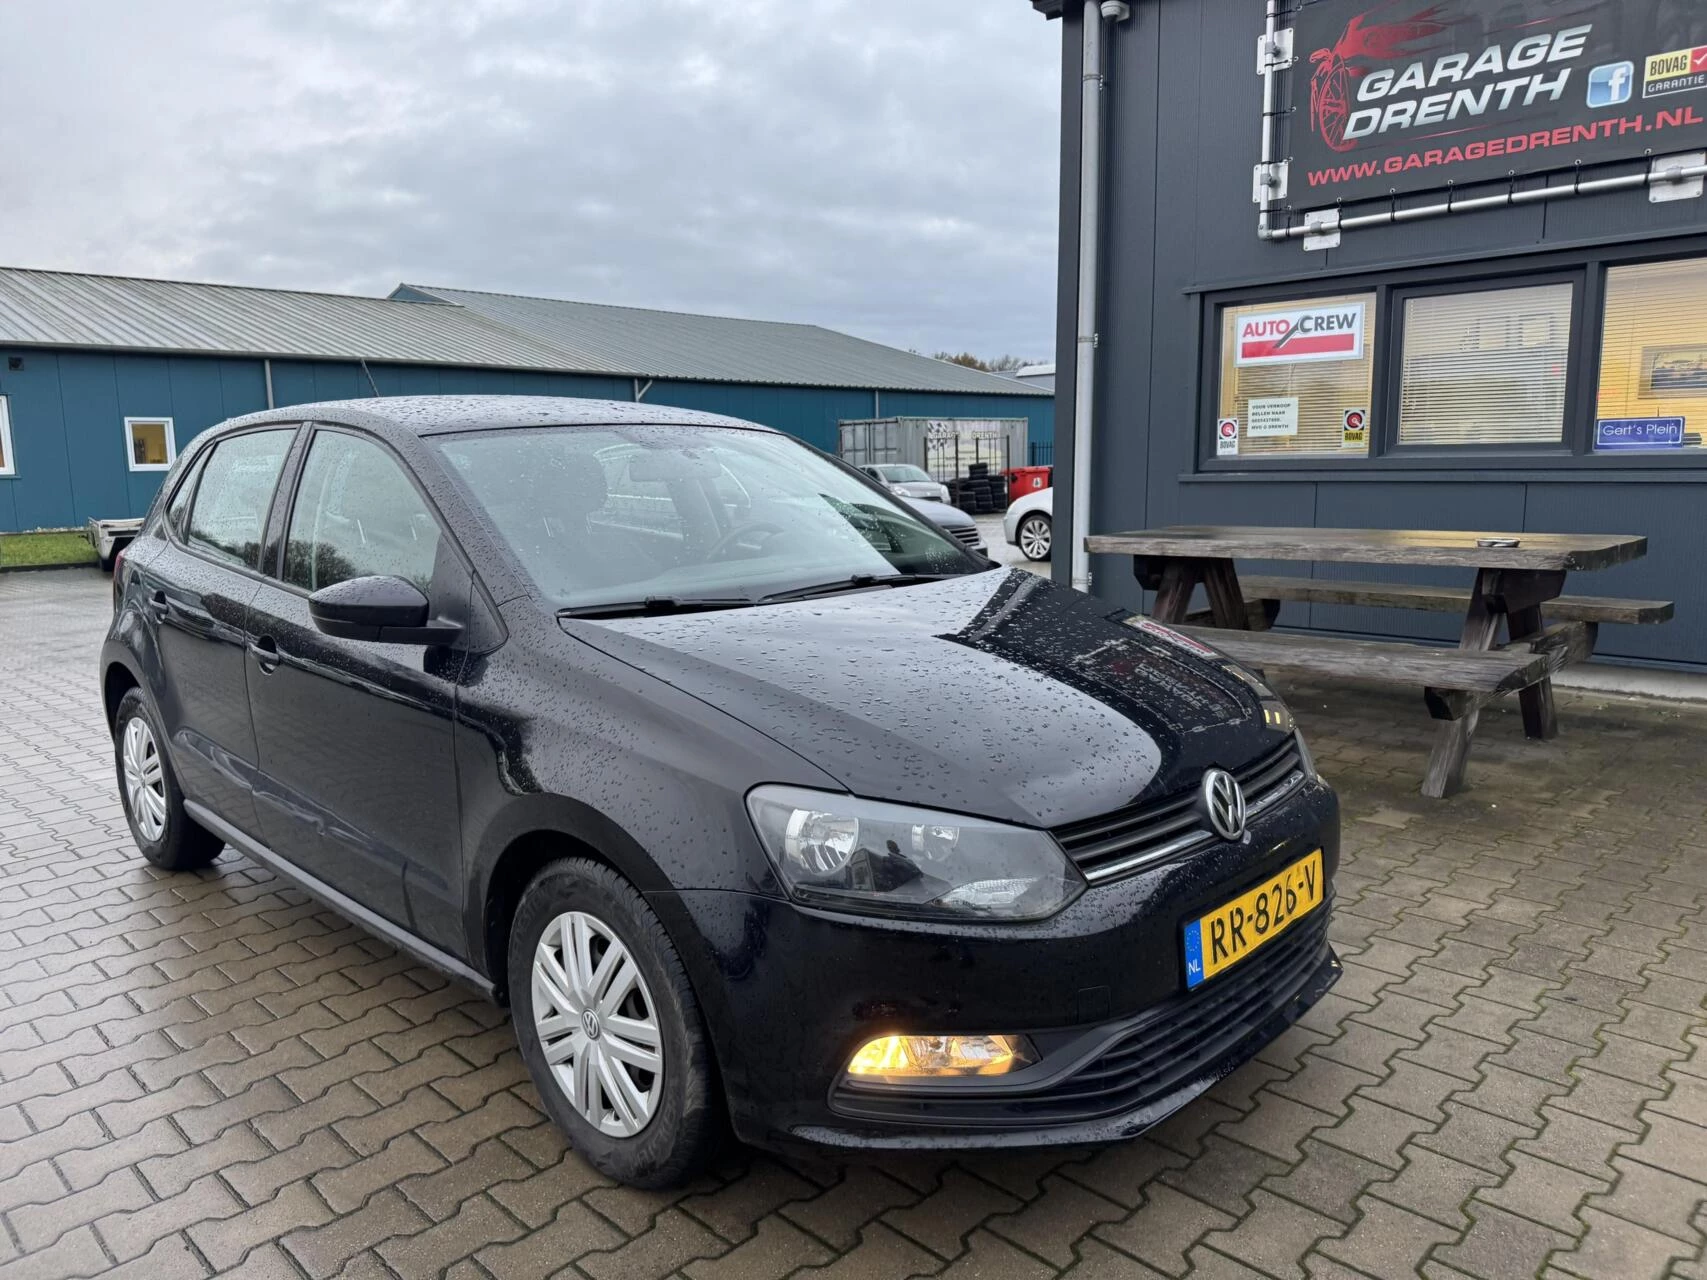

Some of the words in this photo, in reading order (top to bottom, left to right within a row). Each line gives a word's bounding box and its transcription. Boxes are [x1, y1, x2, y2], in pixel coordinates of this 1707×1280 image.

[1357, 24, 1592, 102] GARAGE
[1650, 55, 1688, 77] BOVAG
[1647, 74, 1705, 93] GARANTIE
[1343, 68, 1571, 141] DRENTH
[1307, 106, 1704, 186] WWW.GARAGEDRENTH.NL
[1242, 319, 1290, 338] AUTO
[1300, 313, 1357, 333] CREW
[1344, 432, 1363, 441] BOVAG
[1602, 425, 1642, 436] Gert's
[1646, 422, 1678, 435] Plein
[1210, 860, 1317, 965] RR-826-V
[1188, 958, 1201, 976] NL
